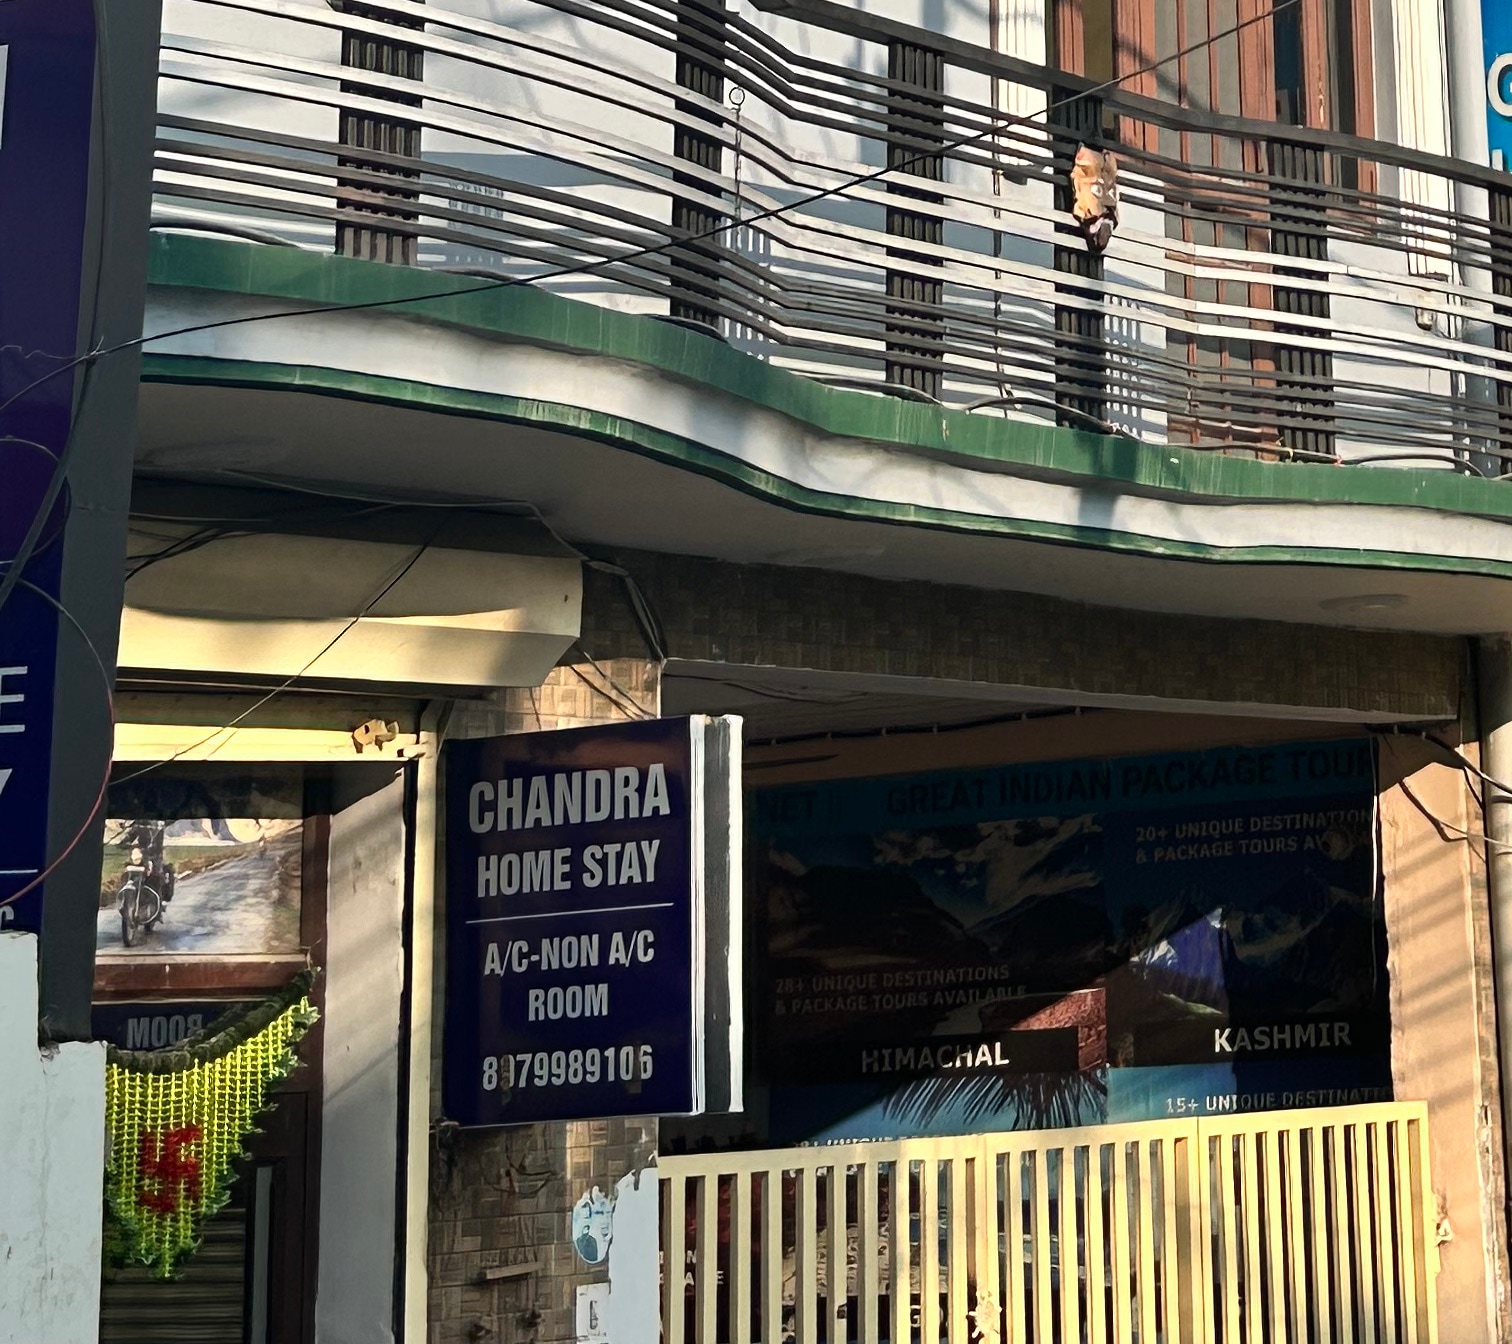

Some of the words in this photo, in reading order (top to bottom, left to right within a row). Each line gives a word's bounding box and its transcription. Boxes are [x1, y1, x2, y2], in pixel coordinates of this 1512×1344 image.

[469, 764, 671, 834] CHANDRA
[887, 776, 993, 818] GREAT
[999, 767, 1111, 807] INDIAN
[1123, 750, 1279, 798] PACKAGE
[1174, 817, 1245, 840] UNIQUE
[1136, 850, 1147, 865] &
[1153, 840, 1233, 864] PACKAGE
[1236, 836, 1298, 854] TOURS
[477, 847, 572, 898] HOME
[582, 839, 661, 889] STAY
[483, 933, 599, 977] A/C-NON
[608, 929, 655, 968] A/C
[812, 974, 878, 993] UNIQUE
[882, 964, 1010, 989] DESTINATIONS
[528, 983, 608, 1021] ROOM
[792, 995, 870, 1015] PACKAGE
[872, 993, 929, 1010] TOURS
[1213, 1022, 1352, 1054] KASHMIR
[861, 1041, 1010, 1073] HIMACHAL
[1165, 1097, 1200, 1114] 15+
[1206, 1092, 1276, 1112] UNIQUE
